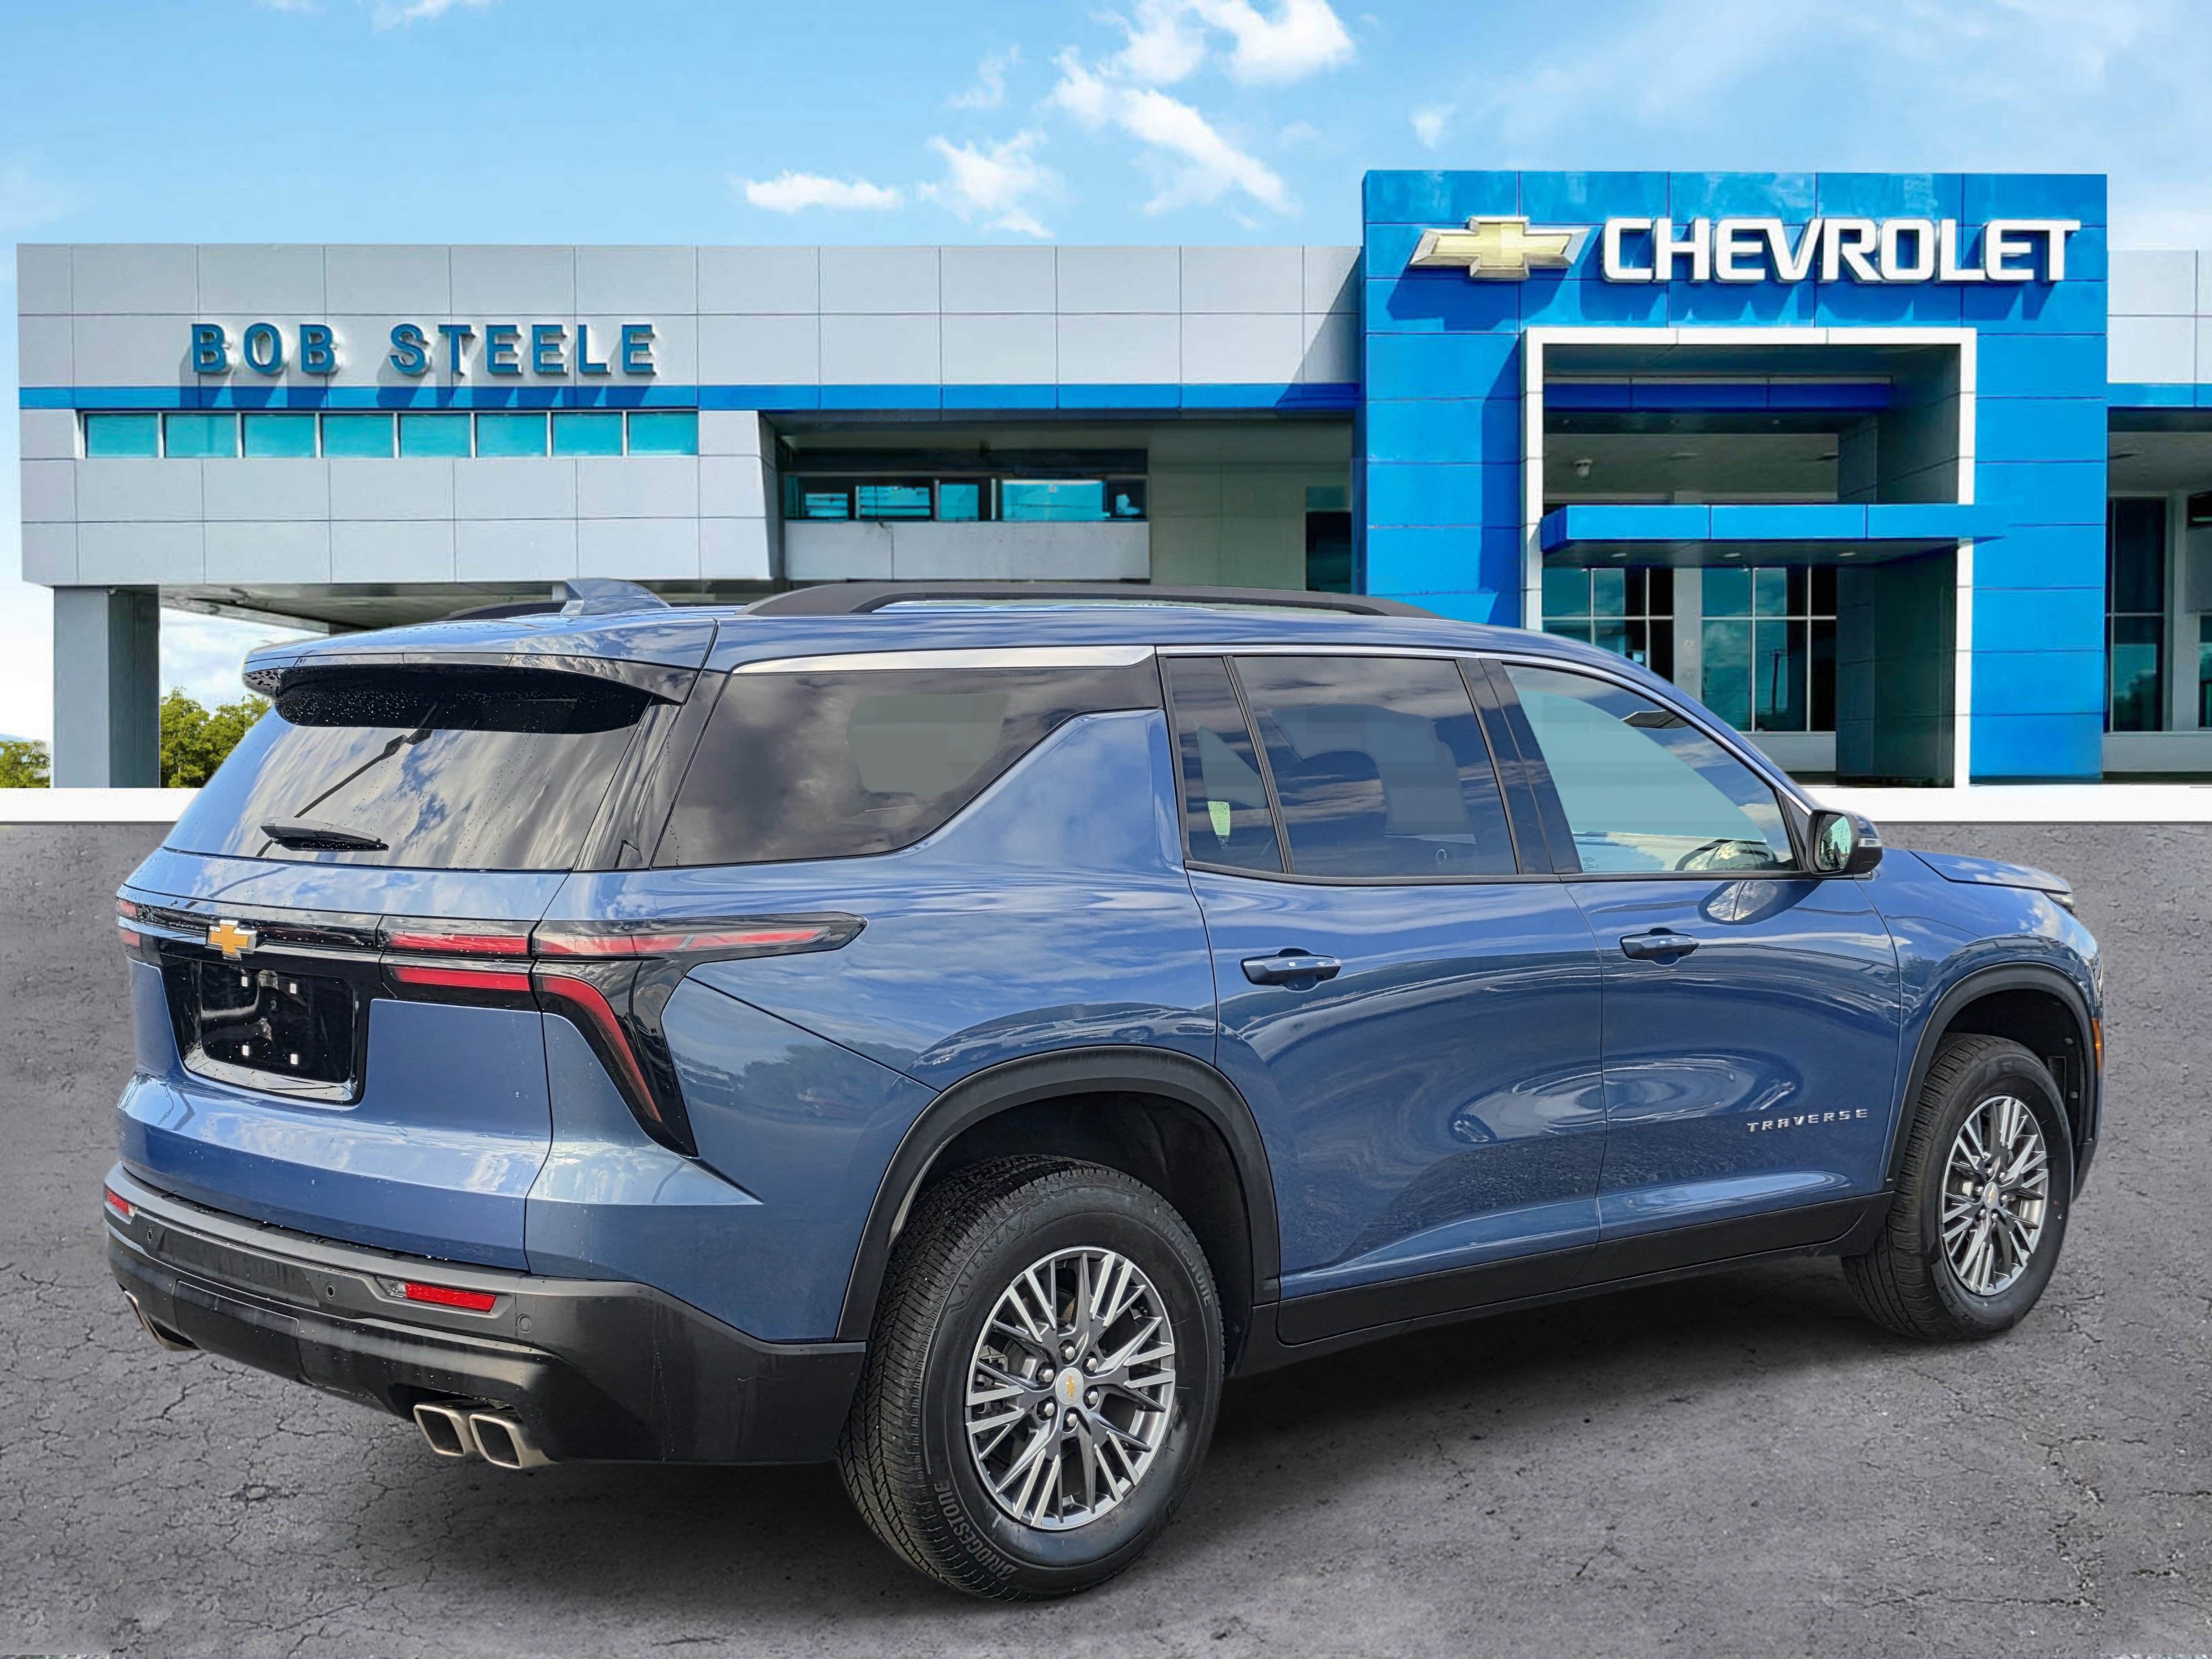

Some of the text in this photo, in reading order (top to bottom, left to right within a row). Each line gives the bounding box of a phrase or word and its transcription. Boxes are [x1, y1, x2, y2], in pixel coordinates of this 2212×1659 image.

[1603, 218, 2081, 282] CHEVROLET
[191, 323, 656, 375] BOB STEELE
[1747, 1109, 1868, 1132] TRAVERSE
[934, 1480, 1018, 1580] BRIDGESTONE
